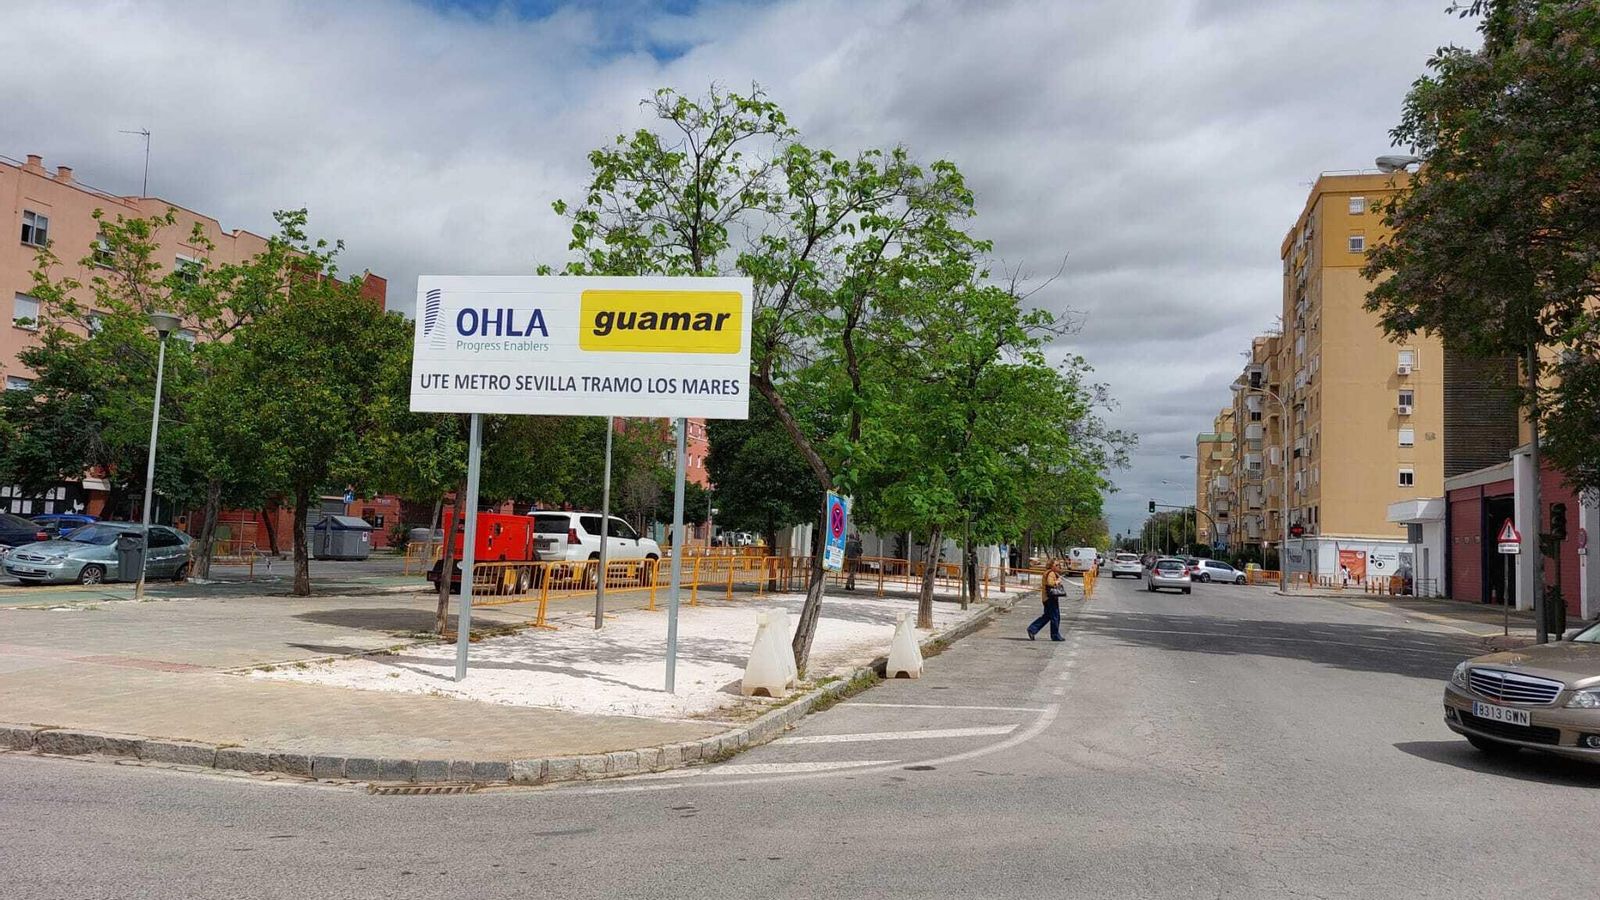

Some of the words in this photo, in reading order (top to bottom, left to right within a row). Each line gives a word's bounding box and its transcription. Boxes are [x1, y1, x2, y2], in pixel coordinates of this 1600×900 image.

[456, 308, 549, 337] OHLA
[593, 311, 731, 336] guamar
[456, 340, 500, 353] Progress
[504, 340, 549, 352] Enablers
[420, 374, 449, 389] UTE
[454, 374, 511, 390] METRO
[515, 375, 577, 391] SEVILLA
[581, 376, 642, 393] TRAMO
[648, 378, 677, 394] LOS
[682, 379, 740, 395] MARES
[1479, 704, 1502, 719] 8313
[1505, 709, 1528, 724] GWN
